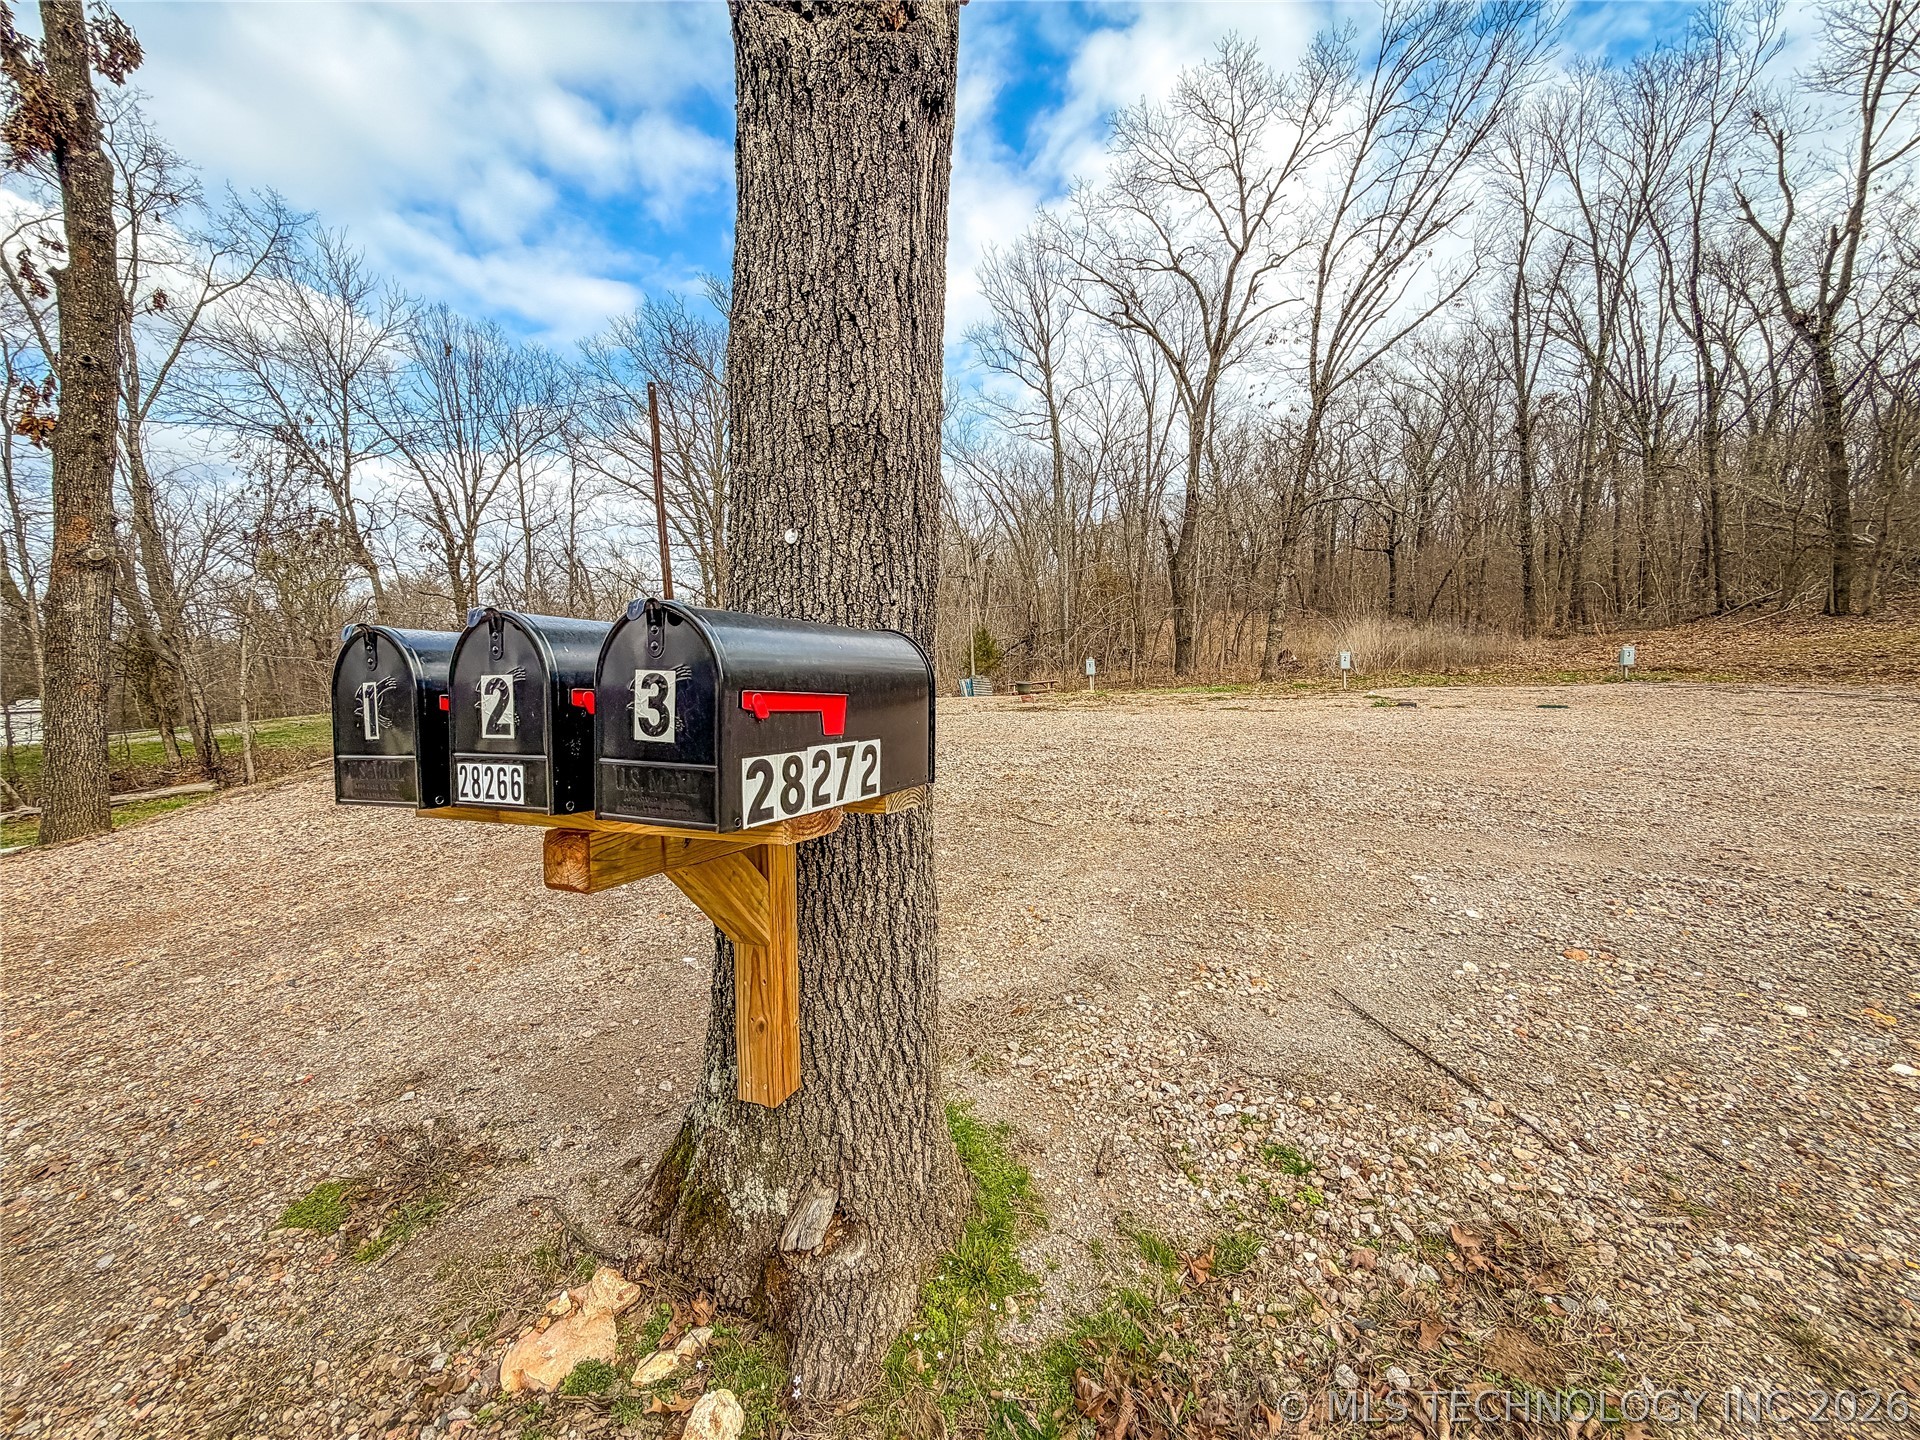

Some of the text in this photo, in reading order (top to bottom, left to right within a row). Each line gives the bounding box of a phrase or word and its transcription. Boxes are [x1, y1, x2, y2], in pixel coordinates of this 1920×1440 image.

[364, 685, 378, 737] 1
[484, 678, 512, 736] 2
[637, 672, 670, 737] 3
[458, 765, 523, 802] 28266
[745, 744, 878, 826] 28272
